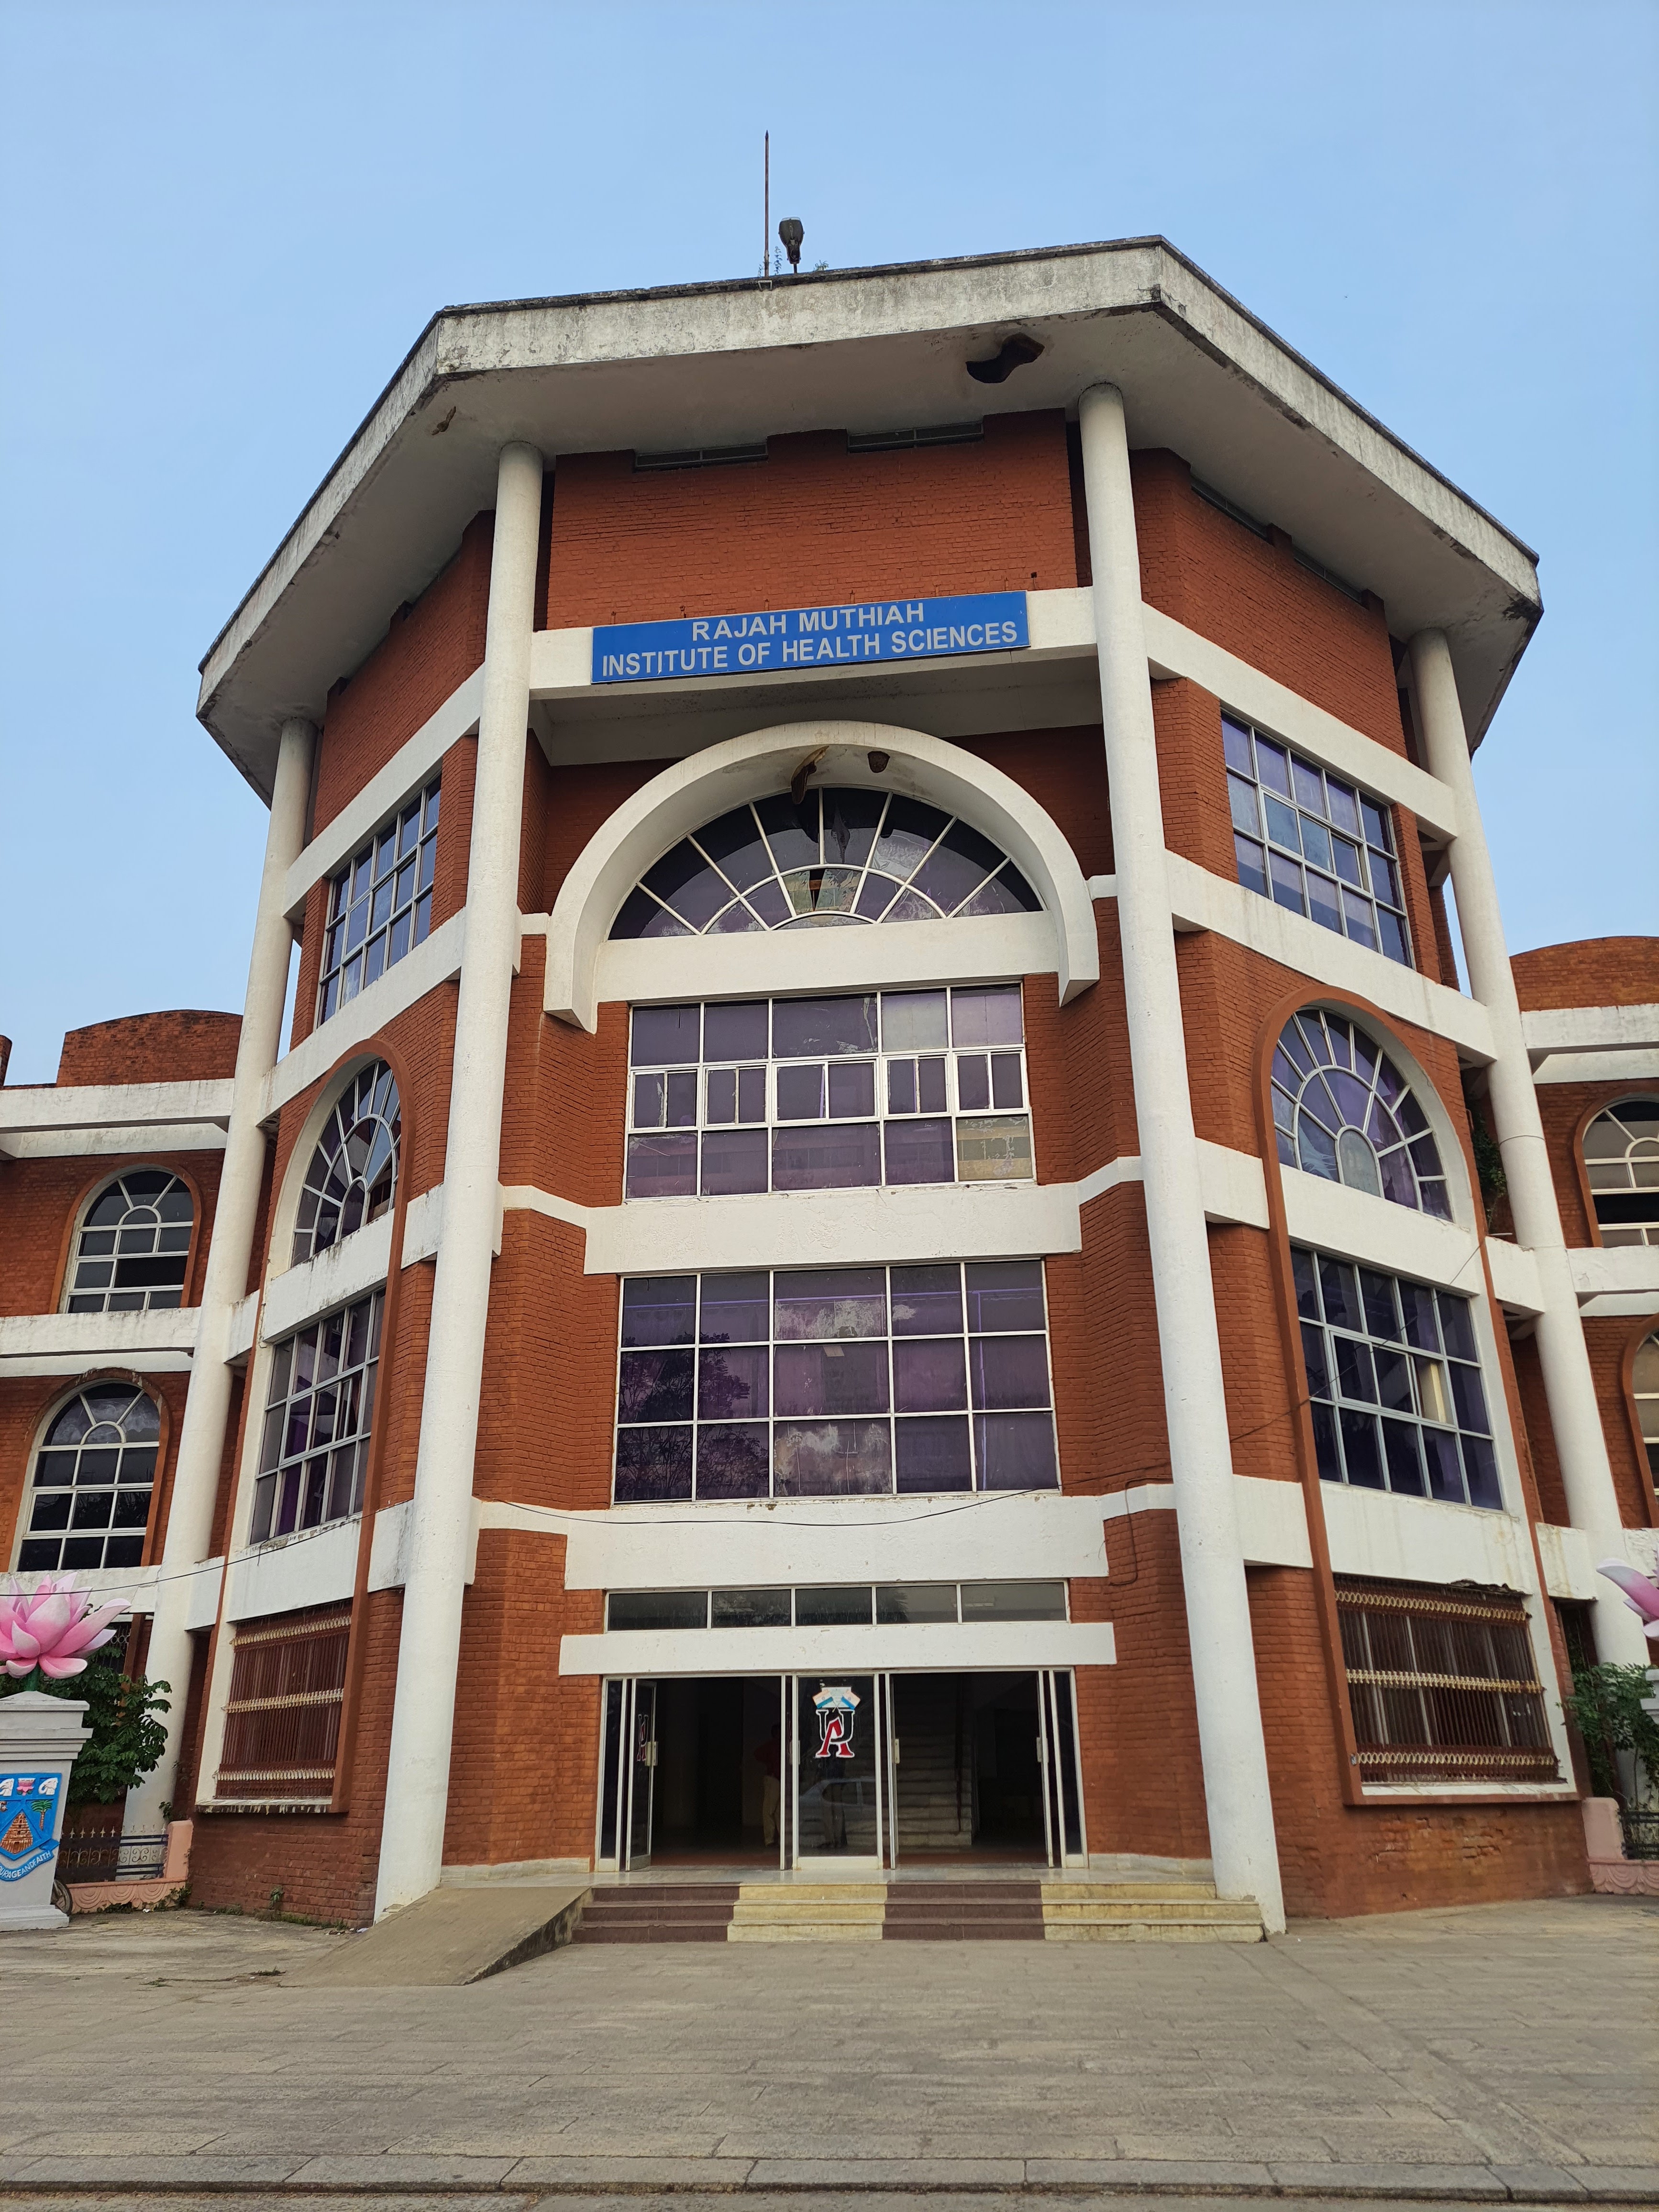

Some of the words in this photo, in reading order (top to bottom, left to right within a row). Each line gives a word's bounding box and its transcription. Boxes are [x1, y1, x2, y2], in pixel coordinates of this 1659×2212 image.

[693, 614, 786, 641] RAJAH
[799, 603, 924, 632] MUTHIAH
[603, 646, 728, 676] INSTITUTE
[738, 642, 771, 665] OF
[783, 633, 880, 662] HEALTH
[891, 621, 1017, 653] SCIENCES
